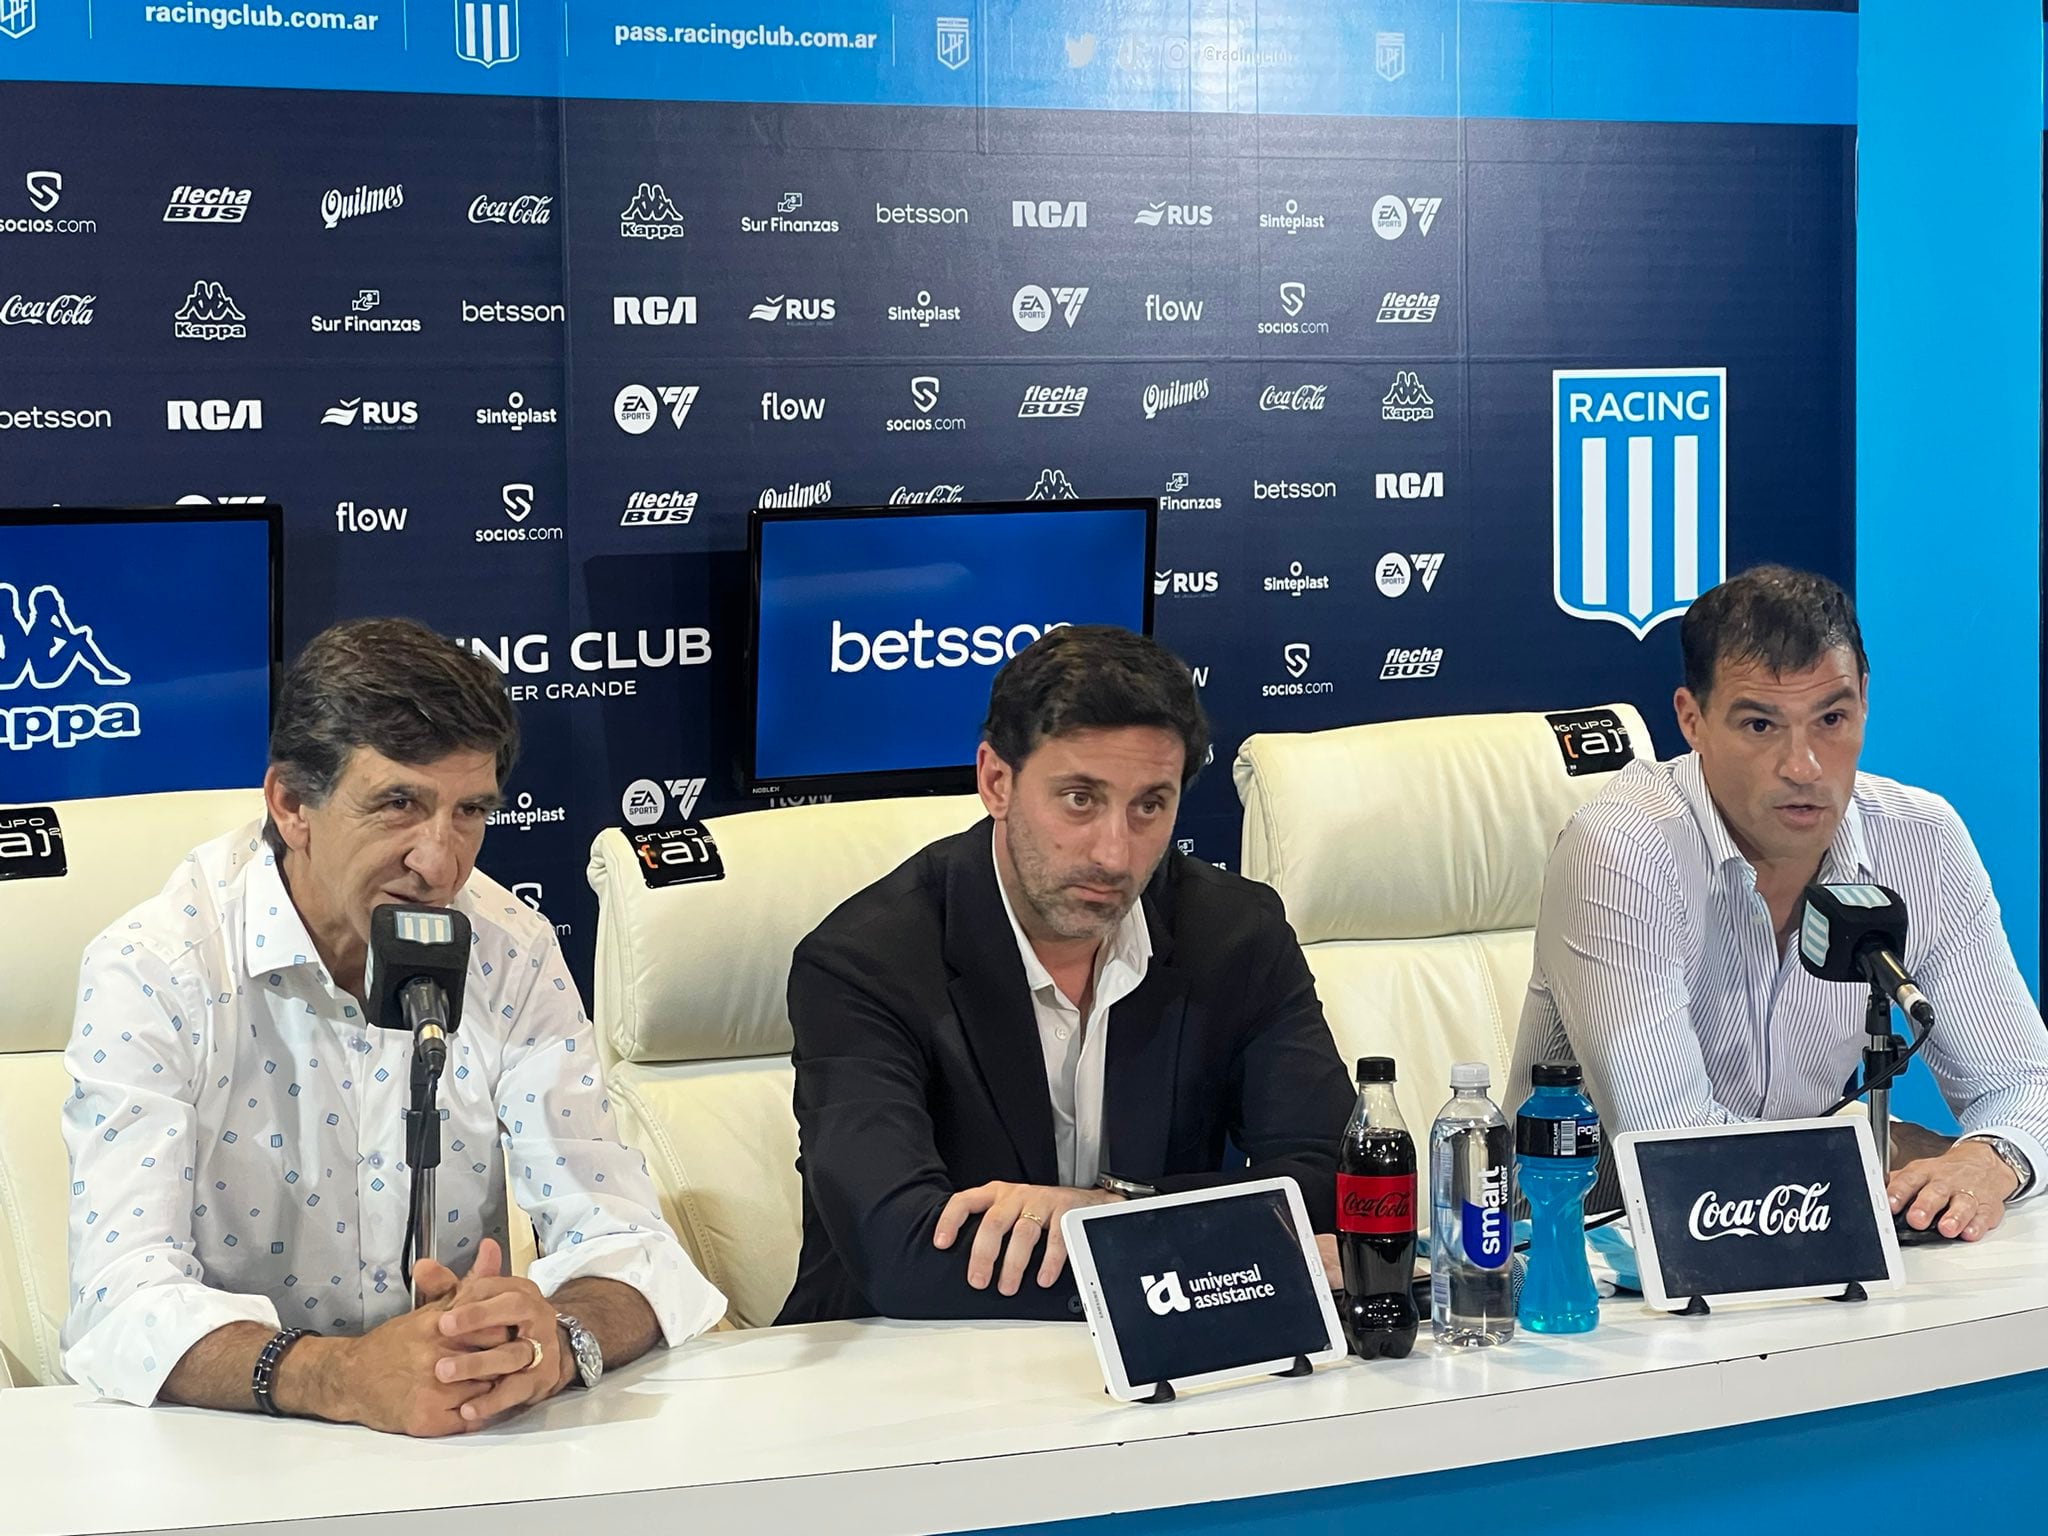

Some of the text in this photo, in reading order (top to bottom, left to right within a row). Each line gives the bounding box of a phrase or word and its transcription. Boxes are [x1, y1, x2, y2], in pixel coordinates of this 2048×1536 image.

[146, 2, 378, 30] racingclub.com.ar
[615, 23, 877, 49] pass.racingclub.com.ar
[170, 186, 252, 204] flecha
[168, 206, 244, 220] BUS
[322, 184, 403, 228] Quilmes
[877, 203, 968, 223] betsson
[1013, 201, 1087, 228] RCA
[1168, 205, 1212, 225] RUS
[621, 222, 684, 239] Kappa
[742, 217, 839, 232] Sur Finanzas
[1259, 214, 1325, 230] Sinteplast
[786, 299, 835, 319] RUS
[1145, 294, 1203, 321] flow
[1382, 292, 1440, 306] flecha
[463, 300, 564, 321] betsson
[614, 297, 696, 325] RCA
[888, 306, 961, 322] Sinteplast
[1380, 308, 1432, 321] BUS
[175, 322, 246, 340] Kappa
[312, 316, 421, 331] Sur Finanzas
[1024, 385, 1089, 402] flecha
[1143, 378, 1209, 419] Quilmes
[168, 400, 262, 430] RCA
[363, 402, 417, 423] RUS
[762, 392, 825, 420] flow
[1022, 403, 1080, 415] BUS
[1382, 406, 1433, 421] Kappa
[1570, 390, 1710, 423] RACING
[476, 408, 558, 427] Sinteplast
[1254, 480, 1336, 499] betsson
[1376, 472, 1443, 498] RCA
[628, 490, 699, 509] flecha
[1160, 496, 1222, 511] Finanzas
[336, 502, 407, 531] flow
[624, 509, 689, 524] BUS
[1174, 572, 1218, 592] RUS
[1263, 575, 1329, 592] Sinteplast
[571, 628, 711, 670] CLUB
[831, 618, 1075, 673] betsso
[1386, 647, 1443, 664] flecha
[1382, 664, 1436, 678] BUS
[546, 681, 636, 699] GRANDE
[629, 806, 658, 816] SPORTS
[1500, 1164, 1508, 1205] water
[1479, 1166, 1500, 1255] smart
[1189, 1263, 1261, 1294] universal
[1194, 1282, 1276, 1309] assistance
